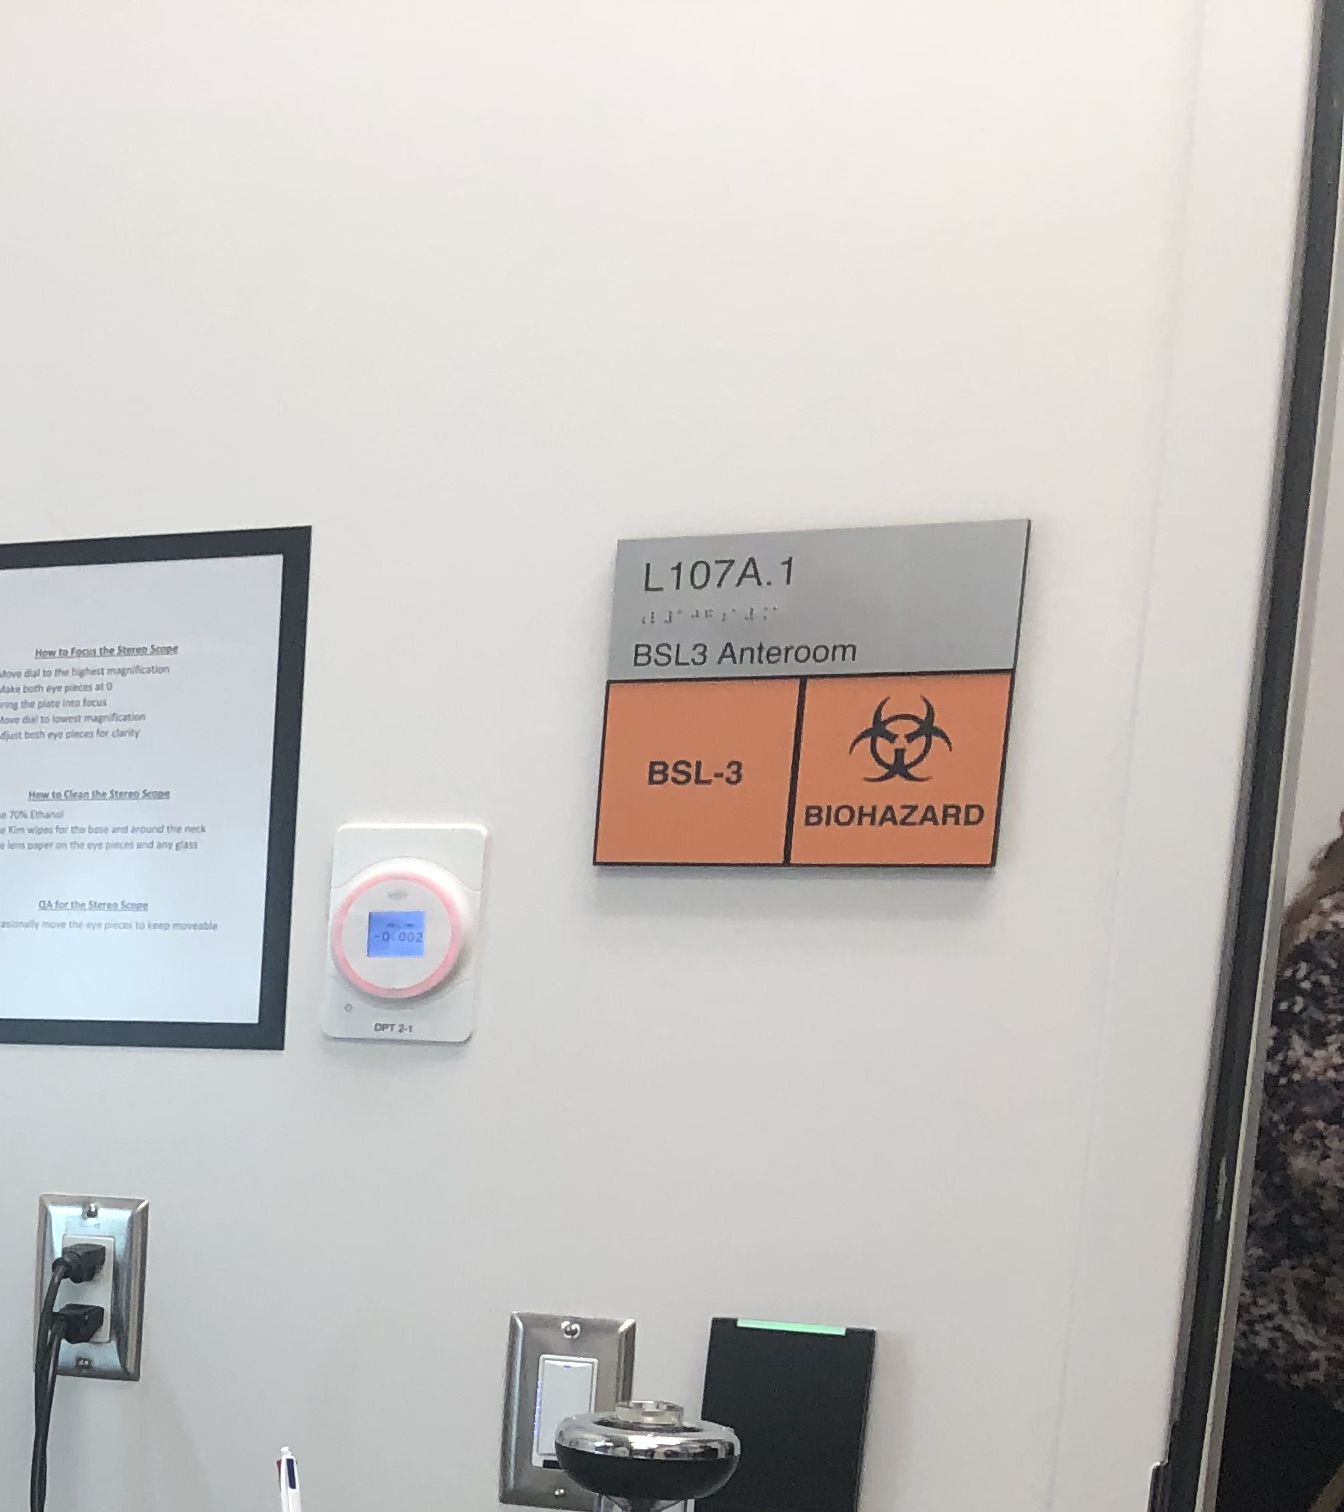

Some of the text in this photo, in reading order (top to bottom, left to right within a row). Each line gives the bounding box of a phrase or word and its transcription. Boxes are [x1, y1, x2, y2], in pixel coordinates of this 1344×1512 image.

[643, 557, 795, 593] L107A.1
[35, 644, 178, 658] How to Focus the Stereo Scope
[632, 641, 857, 667] BSL3 Anteroom
[24, 669, 40, 678] dial
[43, 669, 52, 677] to
[54, 668, 69, 677] the
[72, 666, 104, 678] highest
[107, 665, 170, 677] magnification
[23, 684, 44, 693] both
[46, 685, 62, 694] eye
[64, 683, 92, 693] pieces
[95, 683, 104, 691] at
[21, 699, 35, 708] the
[38, 699, 60, 710] plate
[62, 698, 80, 707] into
[83, 697, 107, 707] focus
[22, 715, 38, 724] dial
[41, 715, 50, 723] to
[52, 714, 82, 723] lowest
[84, 712, 146, 724] magnification
[24, 730, 45, 739] both
[47, 730, 63, 740] eye
[66, 729, 94, 739] pieces
[96, 728, 109, 738] for
[112, 728, 140, 739] clarity
[647, 761, 744, 785] BSL-3
[28, 789, 170, 800] How to Clean the Stereo Scope
[10, 810, 28, 819] 70%
[30, 810, 64, 819] Ethanol
[803, 804, 985, 827] BIOHAZARD
[8, 825, 25, 834] Kim
[27, 826, 53, 835] wipes
[55, 825, 68, 834] for
[71, 825, 86, 834] the
[88, 825, 109, 834] base
[112, 825, 128, 833] and
[131, 825, 164, 834] around
[167, 825, 182, 833] the
[184, 825, 206, 833] neck
[7, 841, 26, 849] lens
[28, 842, 53, 851] paper
[70, 841, 85, 849] the
[87, 842, 103, 851] eye
[105, 841, 134, 851] pieces
[137, 841, 154, 849] and
[156, 842, 173, 851] any
[175, 841, 198, 851] glass
[38, 900, 148, 910] QA for the Stereo Scope
[42, 920, 66, 929] move
[69, 920, 84, 929] the
[86, 921, 102, 931] eye
[104, 920, 133, 931] pieces
[135, 921, 145, 929] to
[147, 920, 170, 931] keep
[374, 1023, 395, 1032] DPT
